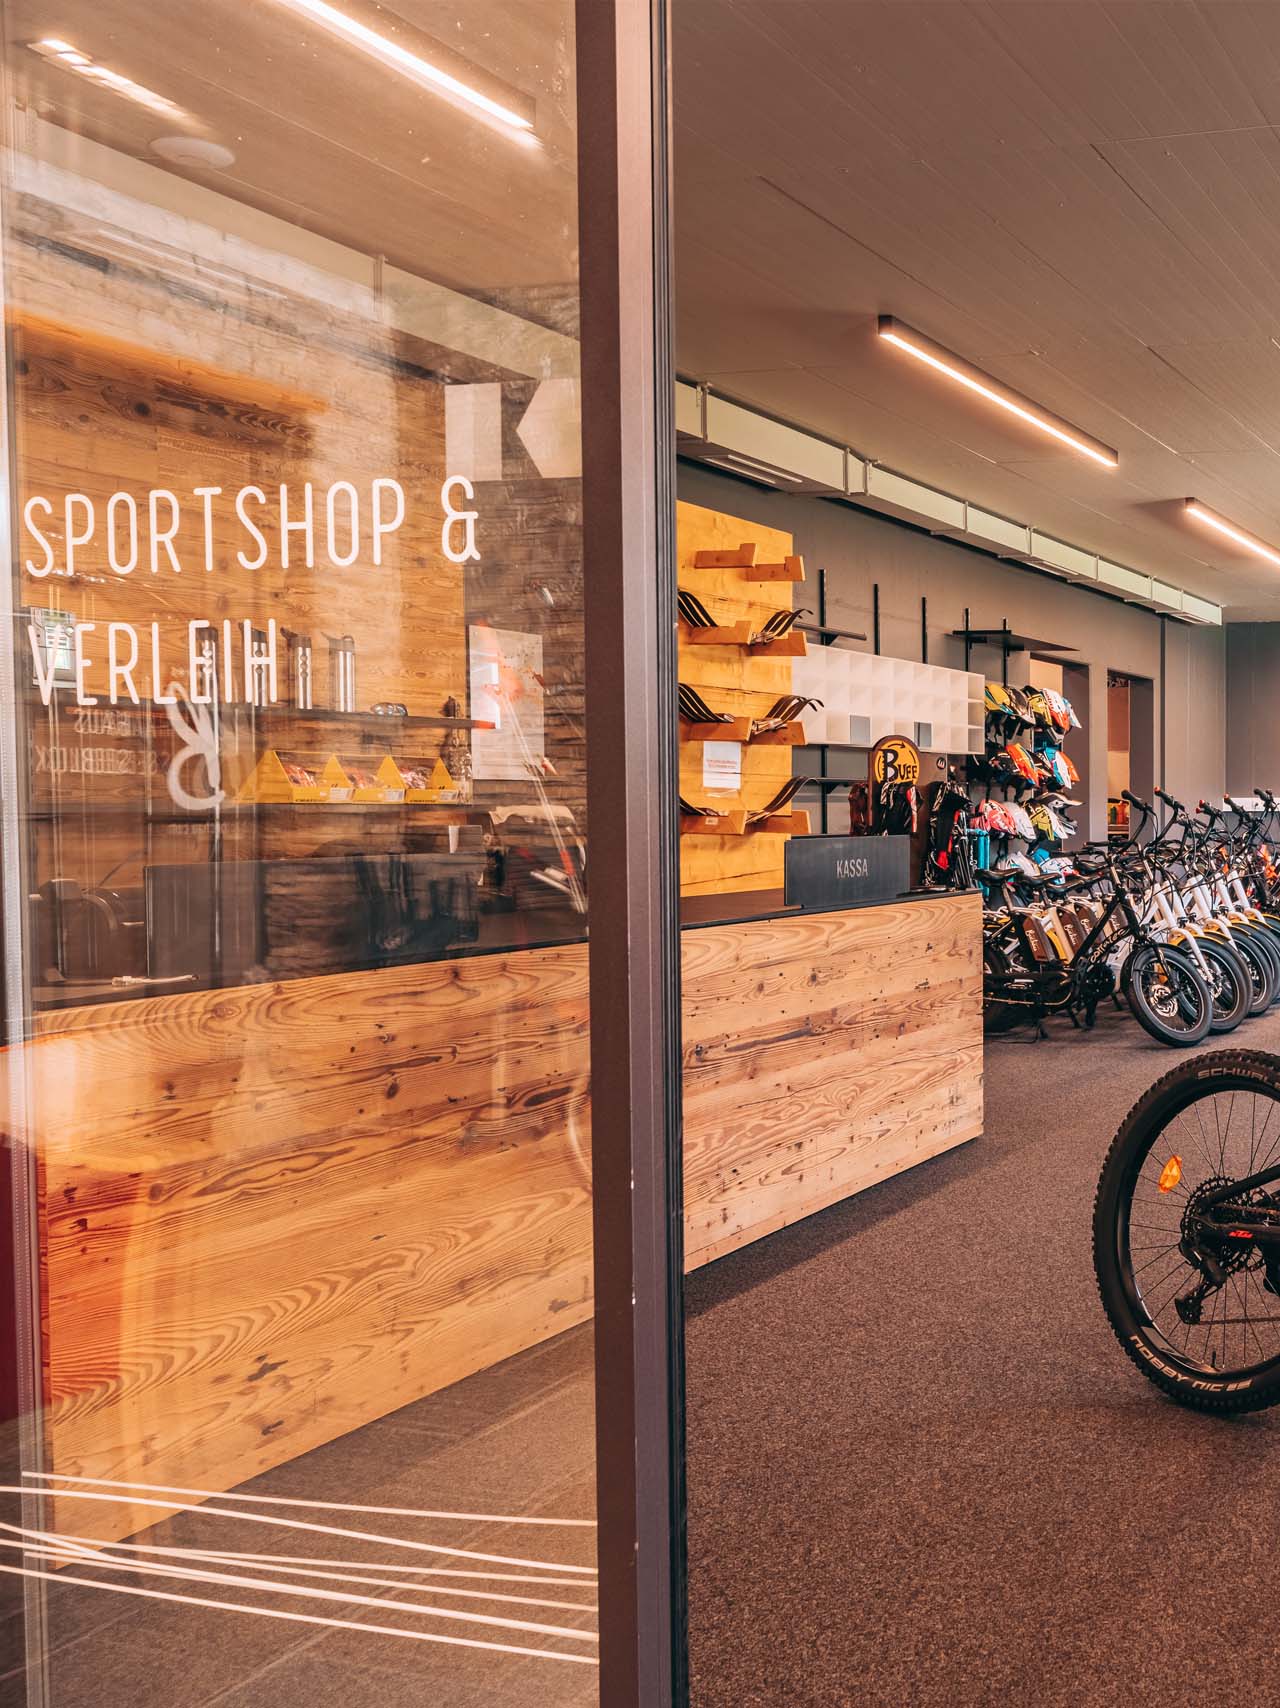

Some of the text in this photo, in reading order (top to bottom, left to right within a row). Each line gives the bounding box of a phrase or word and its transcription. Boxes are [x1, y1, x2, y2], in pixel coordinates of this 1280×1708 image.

[24, 475, 481, 577] SPORTSHOP &
[27, 617, 279, 706] VERLEIH
[836, 858, 869, 878] KASSA
